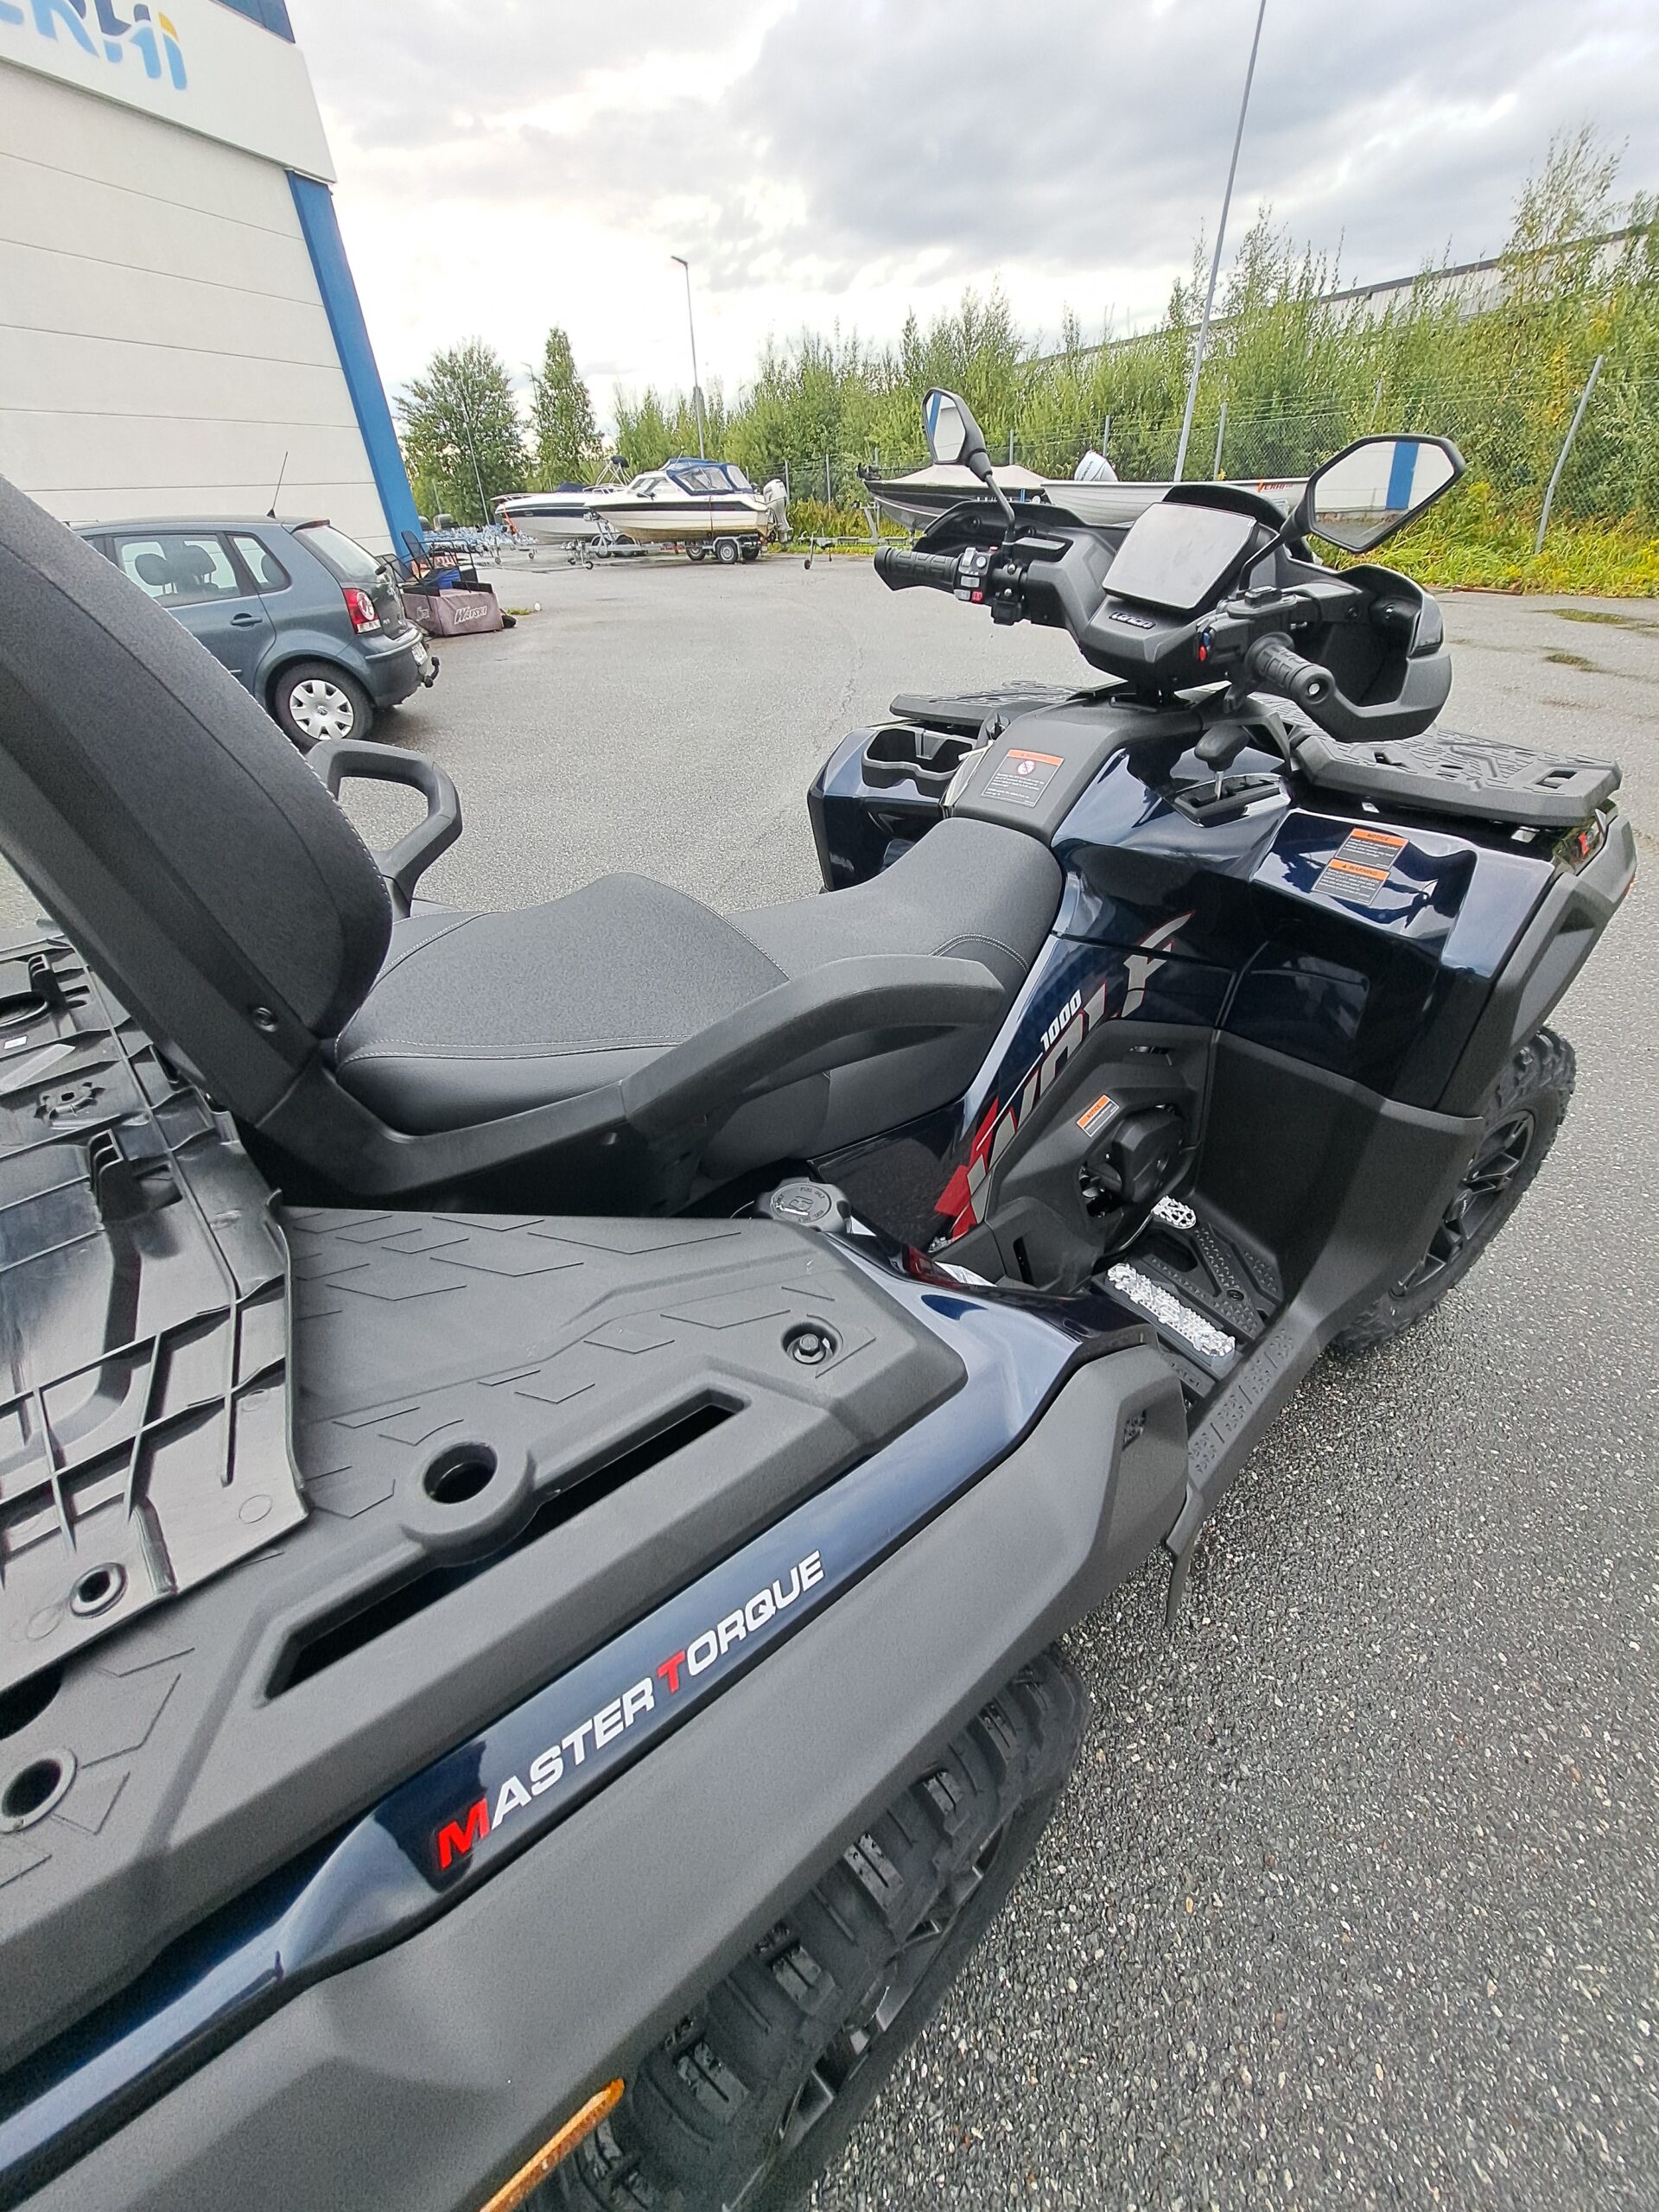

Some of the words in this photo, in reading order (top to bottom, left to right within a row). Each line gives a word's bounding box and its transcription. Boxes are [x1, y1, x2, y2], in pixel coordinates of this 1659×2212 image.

[1039, 988, 1083, 1052] 1000
[438, 1676, 656, 1870] MASTER
[657, 1550, 825, 1694] TORQUE
